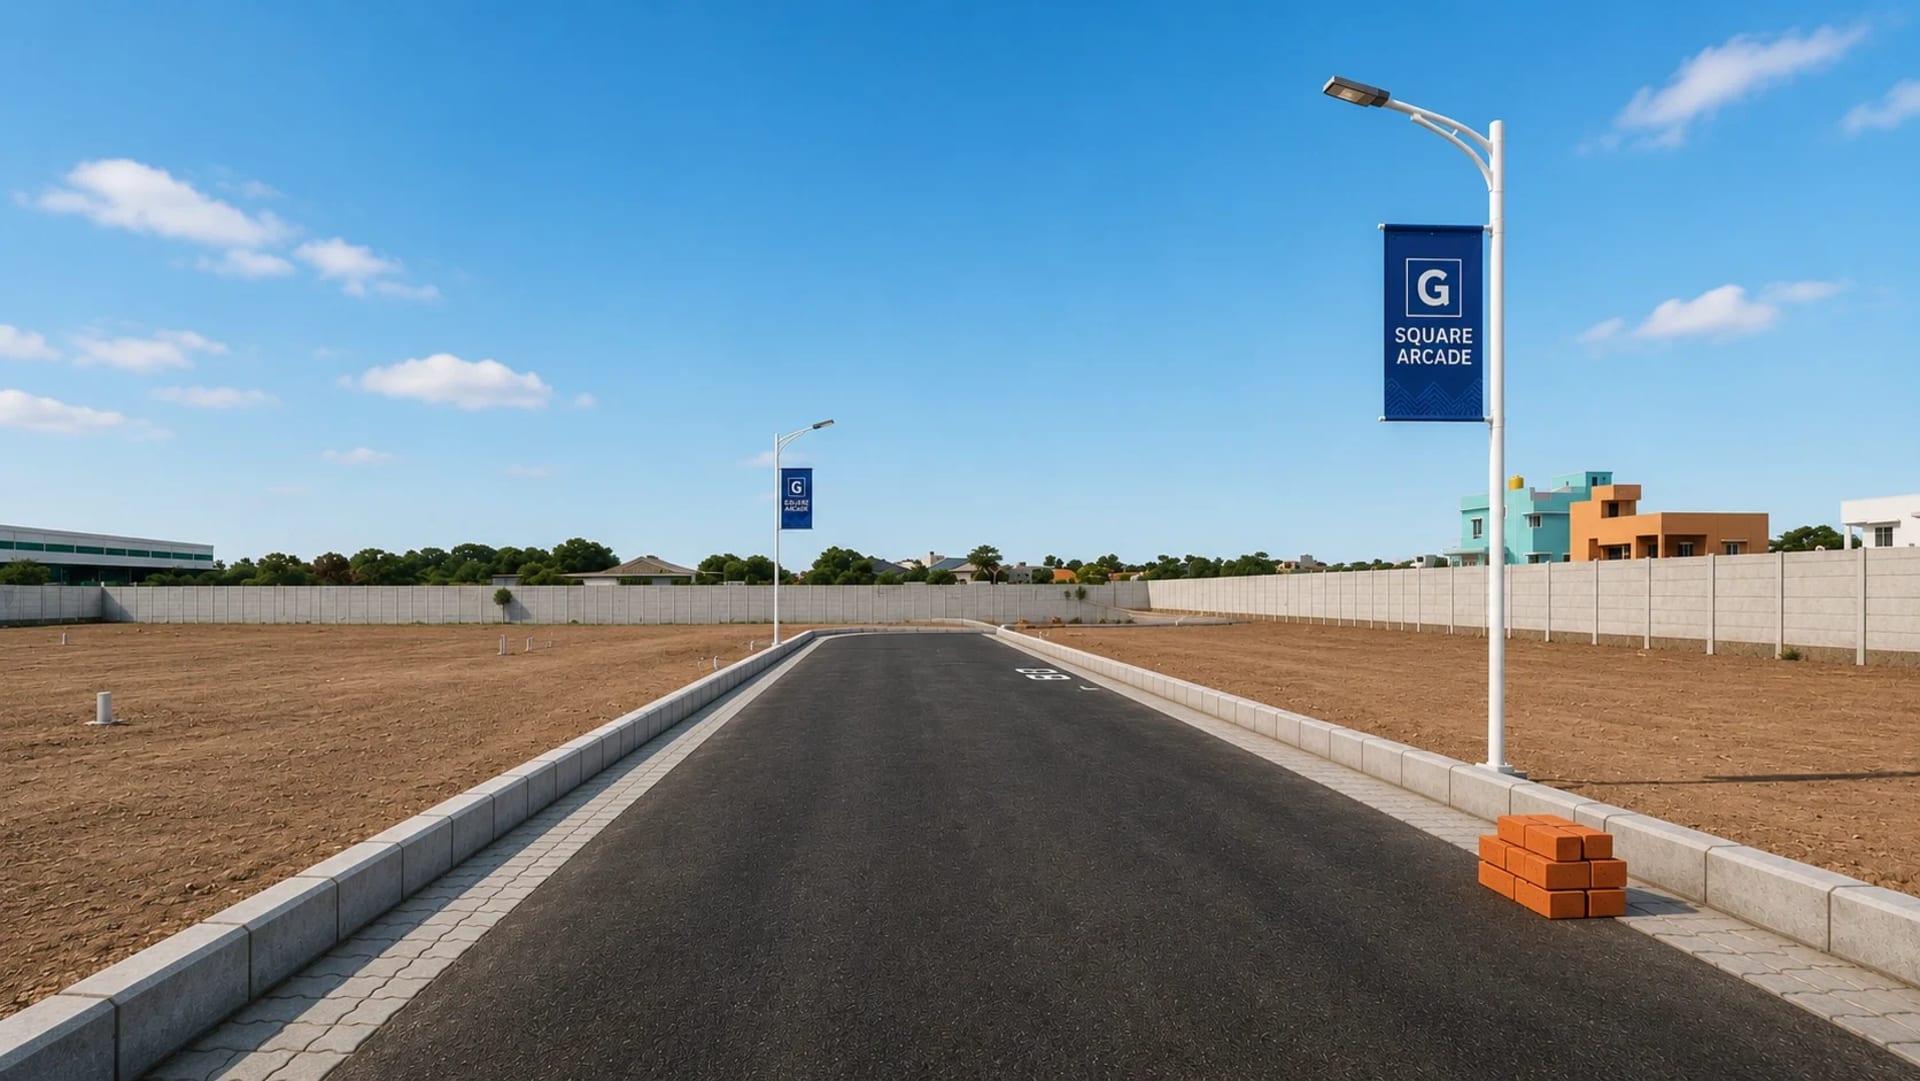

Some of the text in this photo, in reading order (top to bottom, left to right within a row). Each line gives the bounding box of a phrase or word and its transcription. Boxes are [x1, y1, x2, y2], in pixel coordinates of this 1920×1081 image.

[1417, 269, 1450, 306] G
[1395, 327, 1473, 345] SQUARE
[1396, 348, 1472, 365] ARCADE
[791, 480, 802, 494] G
